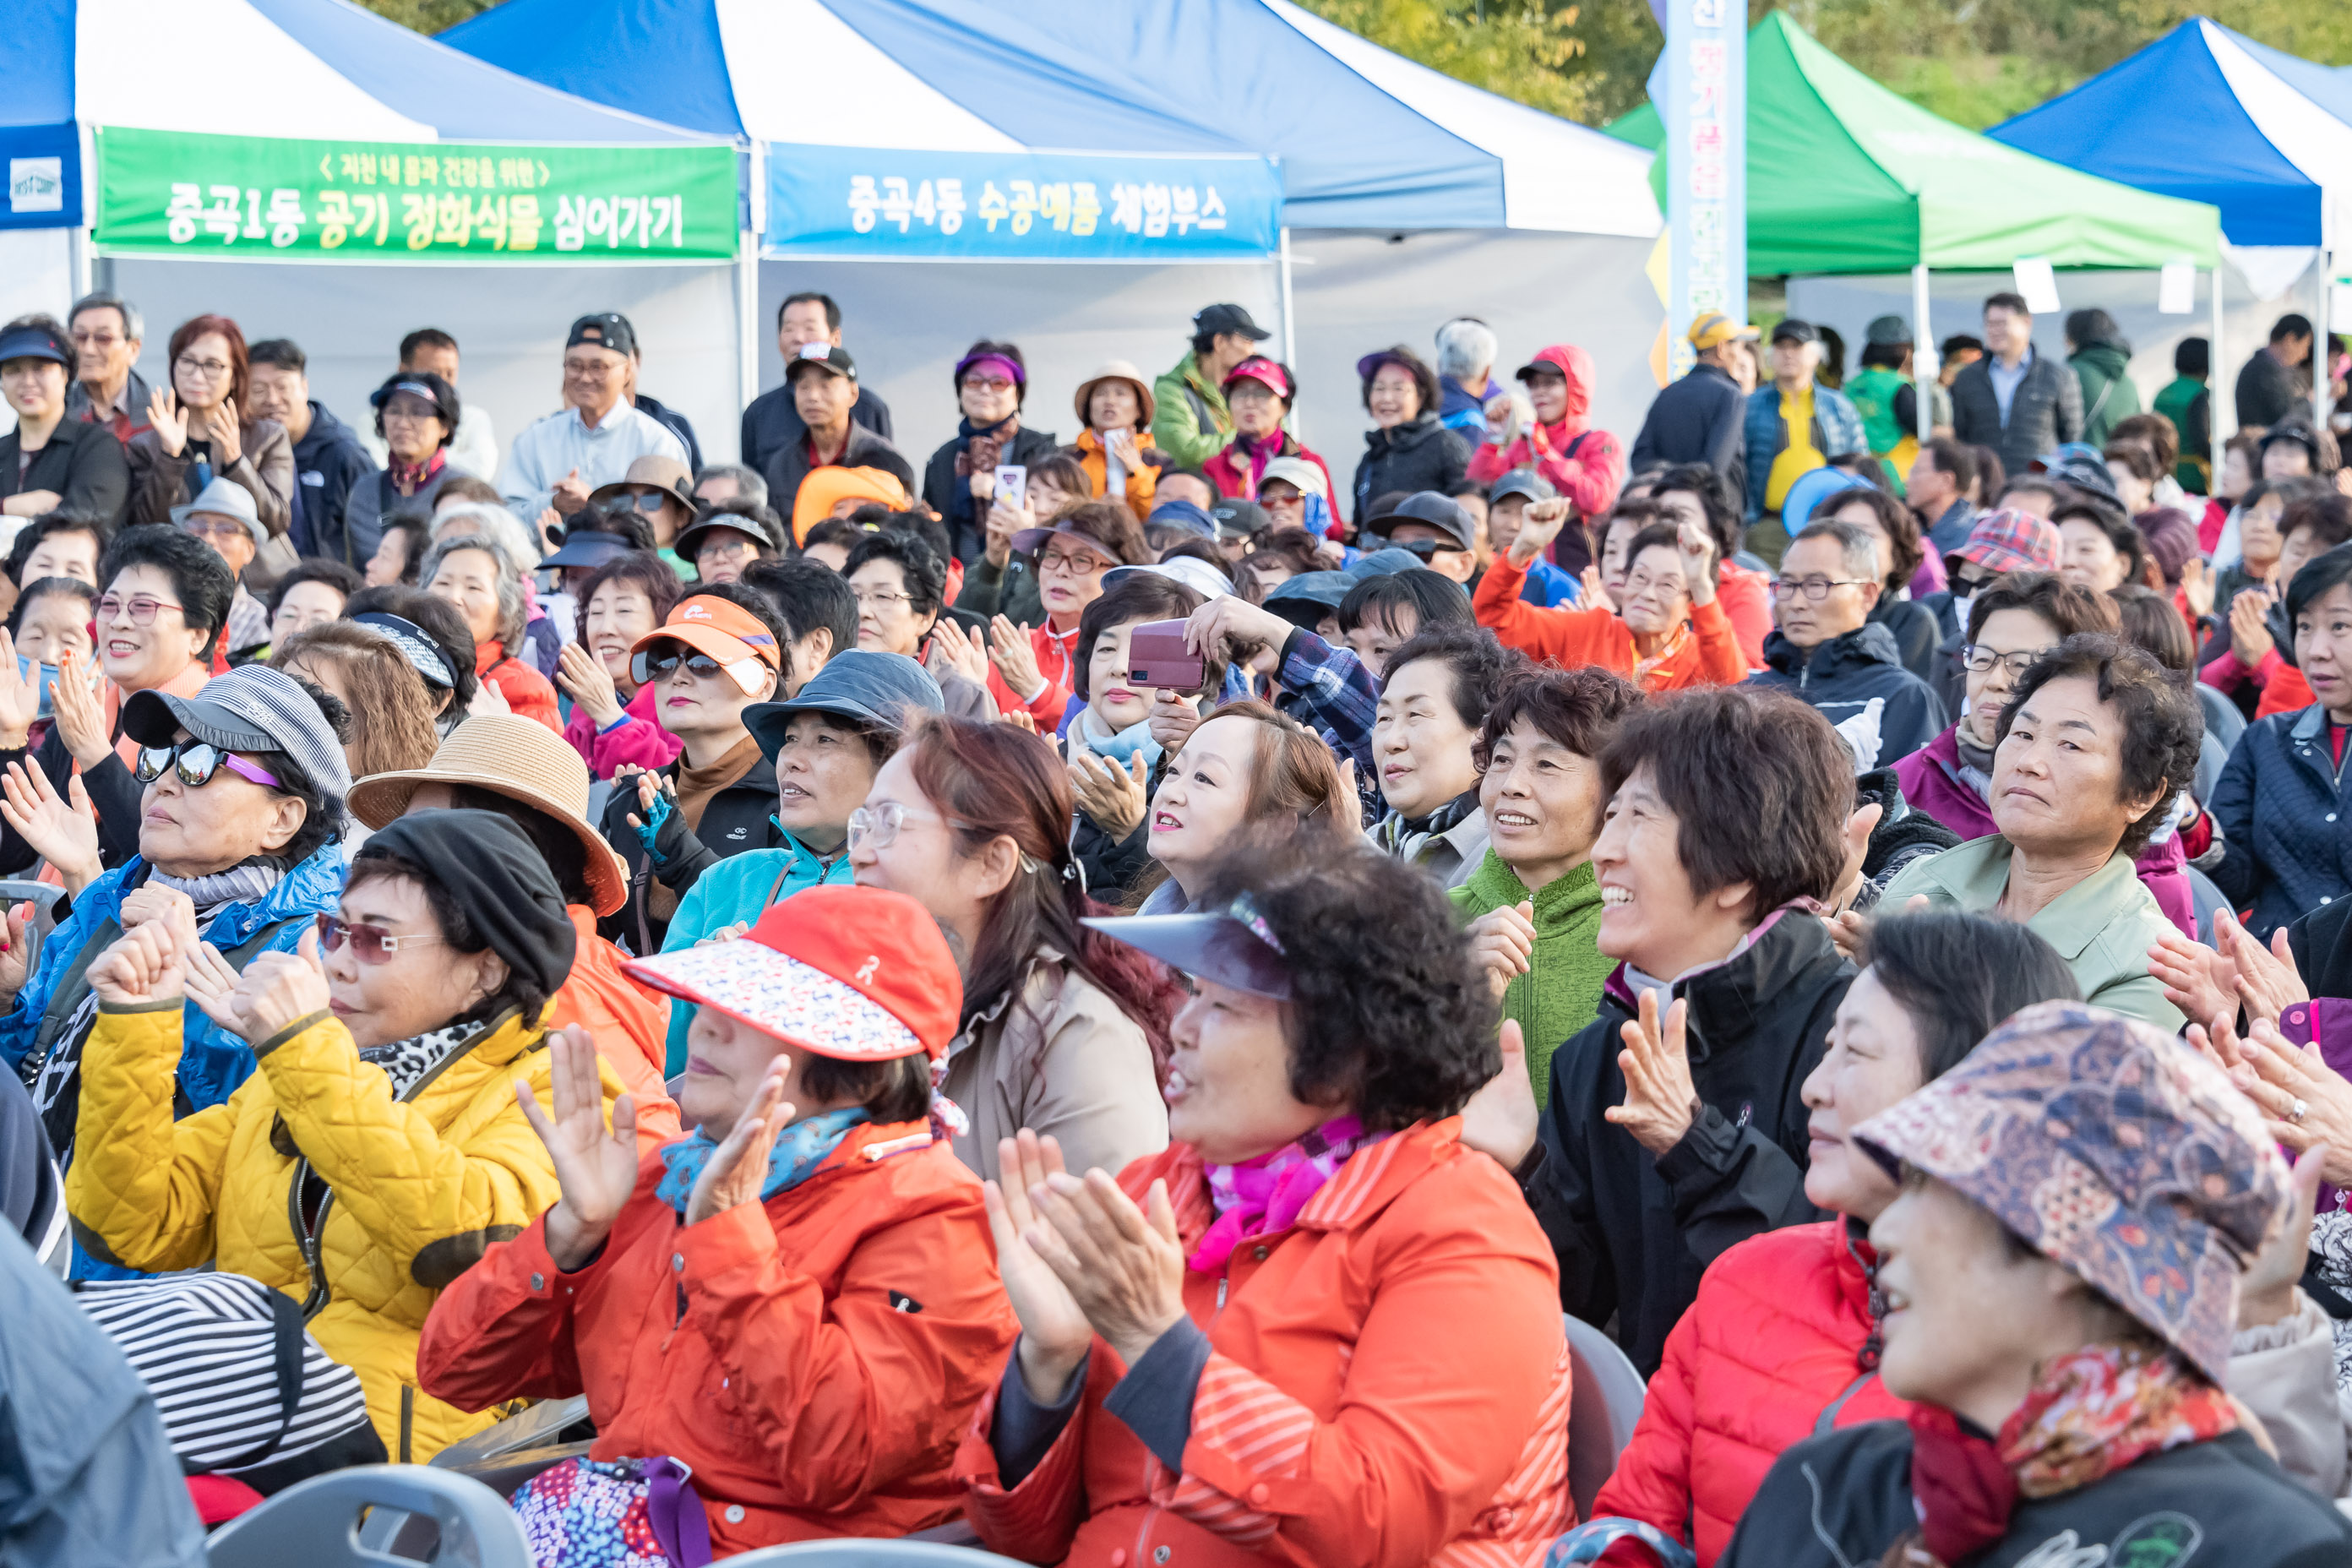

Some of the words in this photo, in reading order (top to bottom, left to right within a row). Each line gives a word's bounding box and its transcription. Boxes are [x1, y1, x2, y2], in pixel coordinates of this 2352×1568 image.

[379, 154, 400, 186] 내
[165, 182, 307, 248] 중곡1동
[315, 189, 391, 249] 공기
[401, 191, 544, 252] 정화식물
[553, 193, 683, 252] 심어가기
[847, 175, 967, 236] 중곡4동
[977, 180, 1102, 237] 수공예품
[1109, 181, 1228, 238] 체험부스
